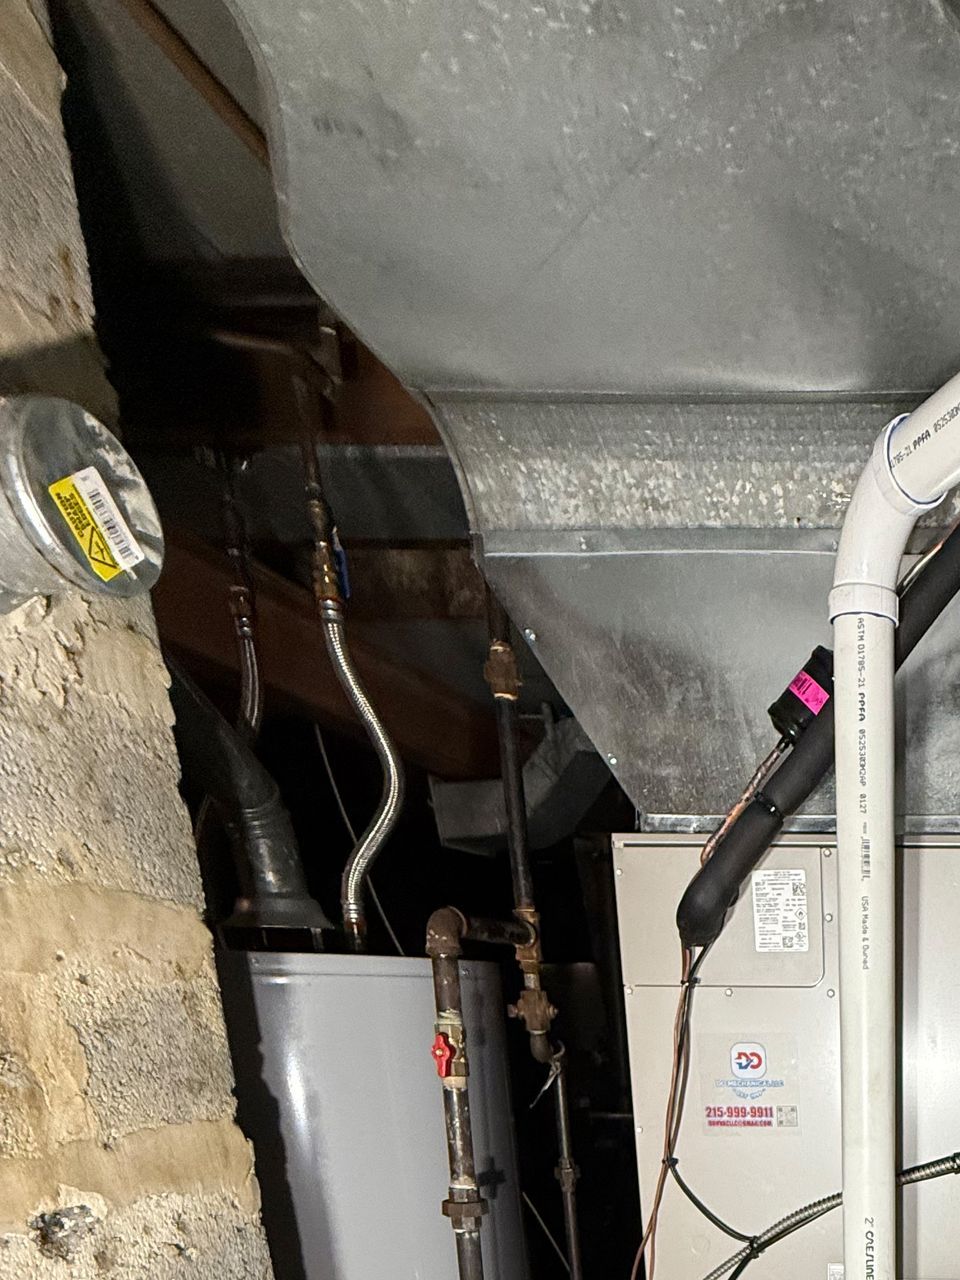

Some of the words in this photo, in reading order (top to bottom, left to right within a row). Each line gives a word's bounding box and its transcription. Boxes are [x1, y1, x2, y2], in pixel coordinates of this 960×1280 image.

[891, 446, 912, 468] 1785-21
[56, 493, 84, 537] CAUTION
[64, 496, 86, 530] SHARP
[69, 493, 90, 527] EDGES
[861, 895, 869, 912] USA
[862, 914, 870, 935] Made
[705, 1106, 773, 1118] 215-999-9911
